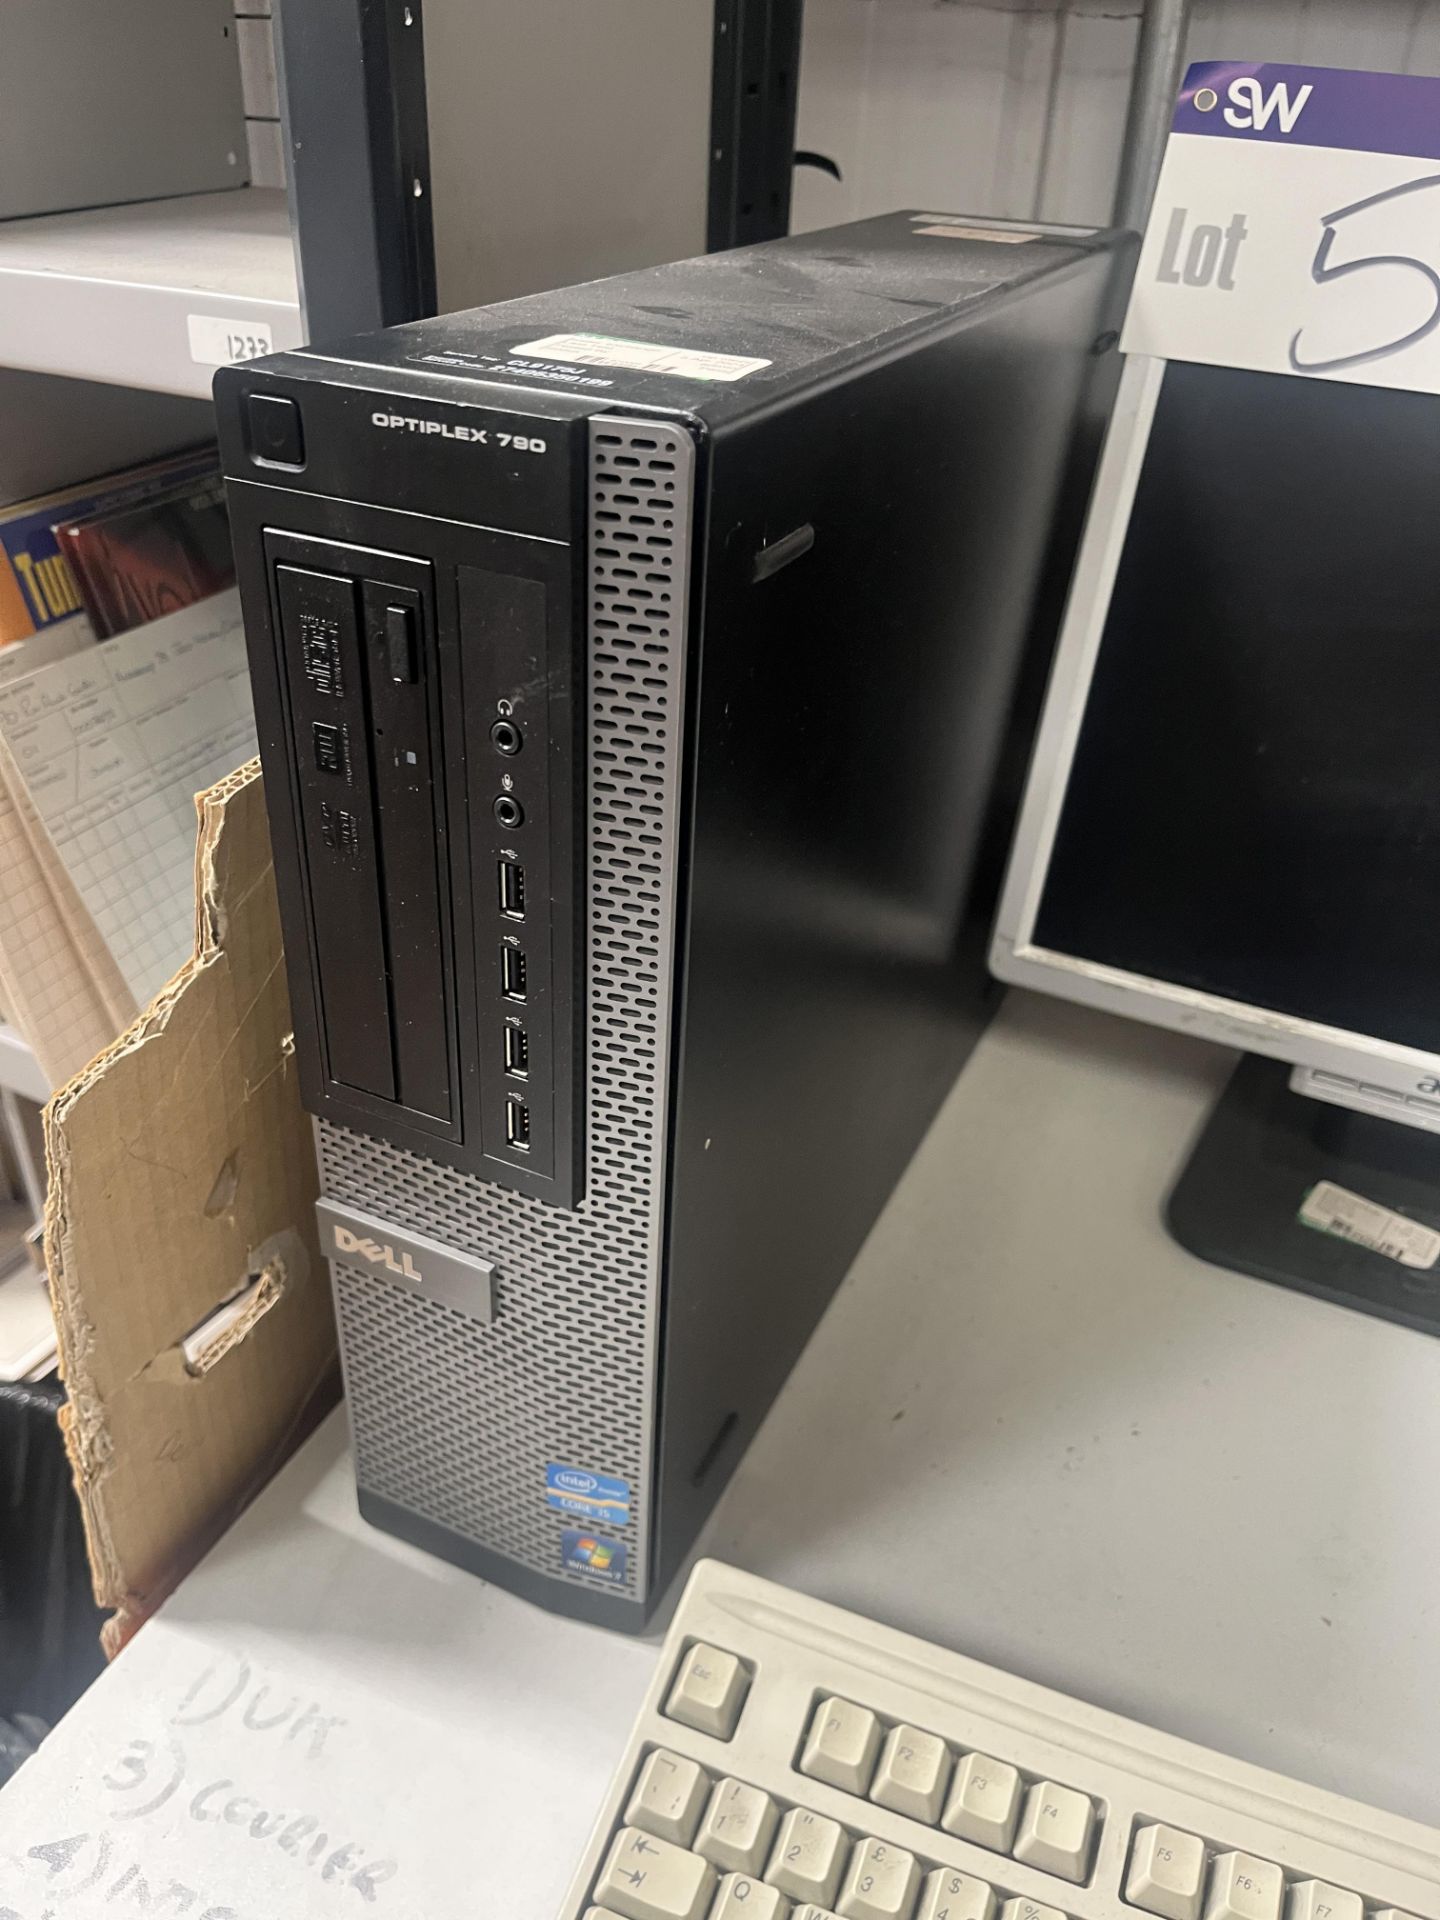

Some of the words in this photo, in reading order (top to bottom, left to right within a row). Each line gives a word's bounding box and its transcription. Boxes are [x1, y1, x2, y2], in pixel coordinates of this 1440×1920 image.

[1223, 77, 1313, 133] SW
[1156, 207, 1248, 291] Lot
[371, 412, 488, 444] OPTIPLEX
[496, 432, 547, 454] 790
[334, 1225, 422, 1282] DELL
[898, 1746, 914, 1761] F2
[970, 1775, 988, 1791] F3
[1042, 1804, 1059, 1819] F4
[787, 1845, 801, 1861] 2
[1157, 1847, 1172, 1862] F5
[860, 1876, 874, 1892] 3
[1236, 1875, 1252, 1890] F6
[734, 1881, 751, 1902] Q
[1315, 1903, 1333, 1918] F7
